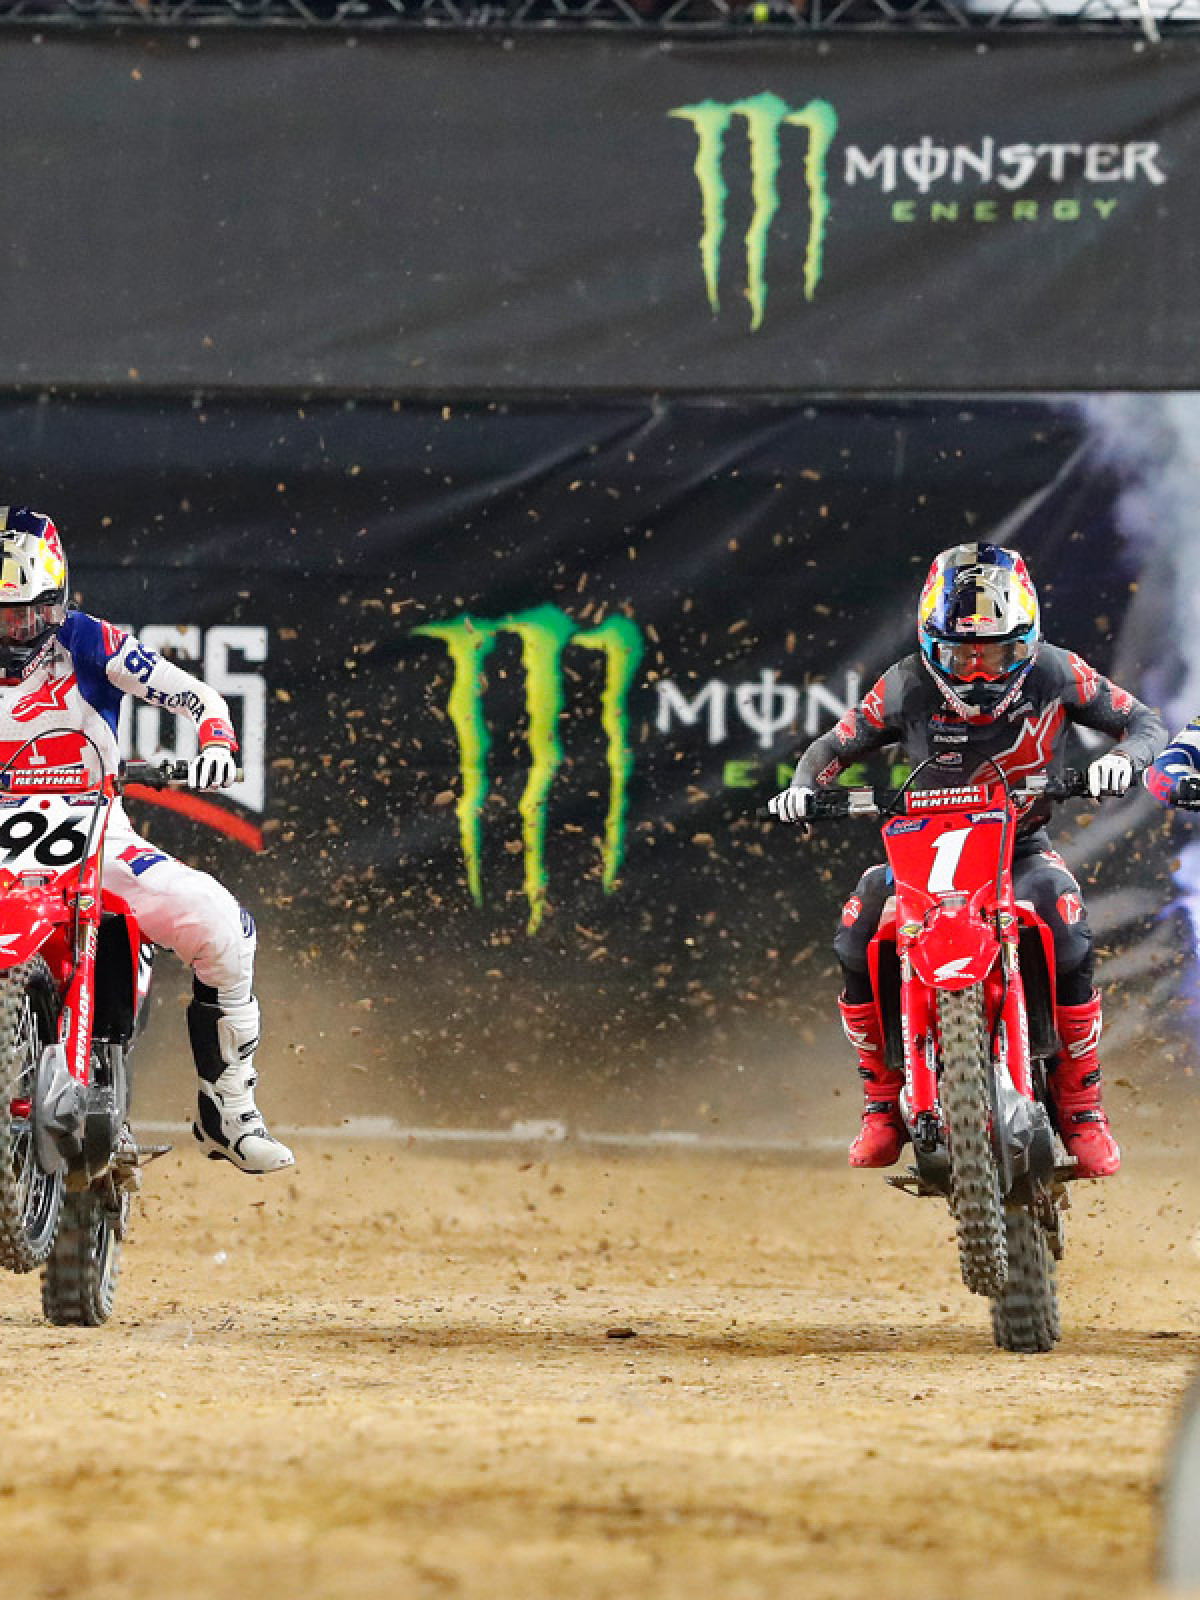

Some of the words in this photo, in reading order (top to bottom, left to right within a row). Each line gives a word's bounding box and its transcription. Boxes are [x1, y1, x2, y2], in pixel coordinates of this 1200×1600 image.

[844, 136, 1167, 192] MONSTER
[894, 200, 1119, 223] ENERGY
[14, 775, 83, 785] RENTHAL
[911, 794, 982, 808] RENTHAL
[925, 827, 971, 894] 1
[75, 984, 91, 1074] DUNLOP
